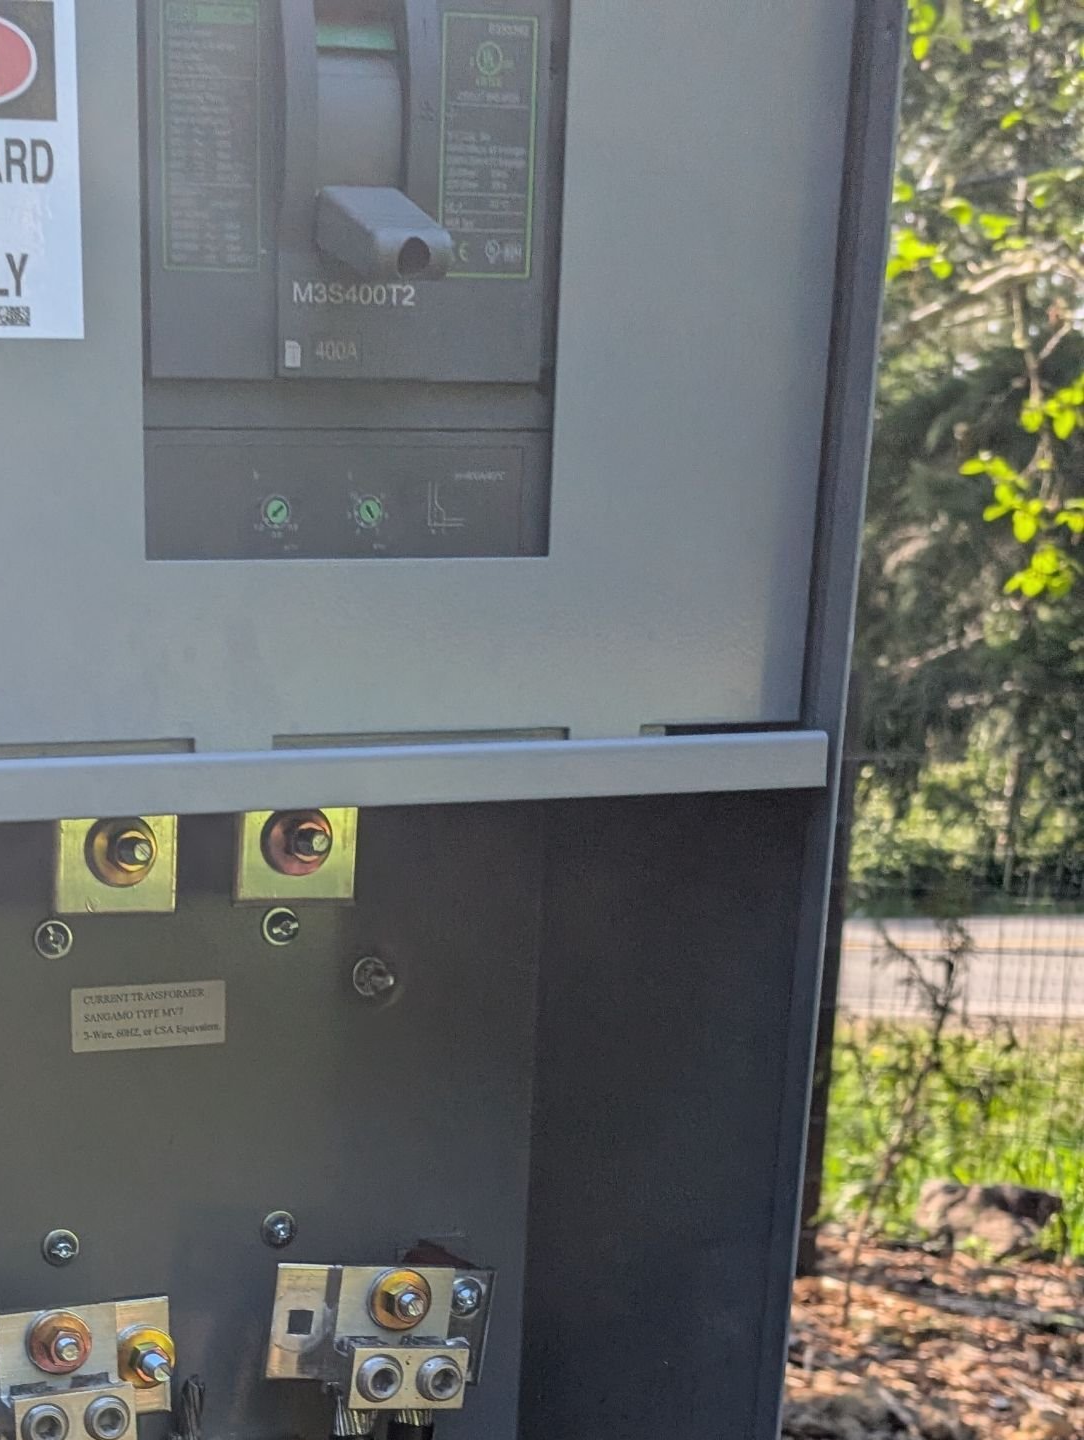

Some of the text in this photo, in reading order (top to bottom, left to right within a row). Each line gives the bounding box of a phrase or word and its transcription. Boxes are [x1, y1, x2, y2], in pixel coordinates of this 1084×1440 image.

[292, 281, 416, 307] M3S400T2
[315, 340, 358, 361] 400A
[83, 988, 206, 1005] CURRENT TRANSFORMER
[83, 1010, 134, 1023] SANGAMO
[136, 1009, 159, 1020] TYPE
[154, 1024, 175, 1036] CSA
